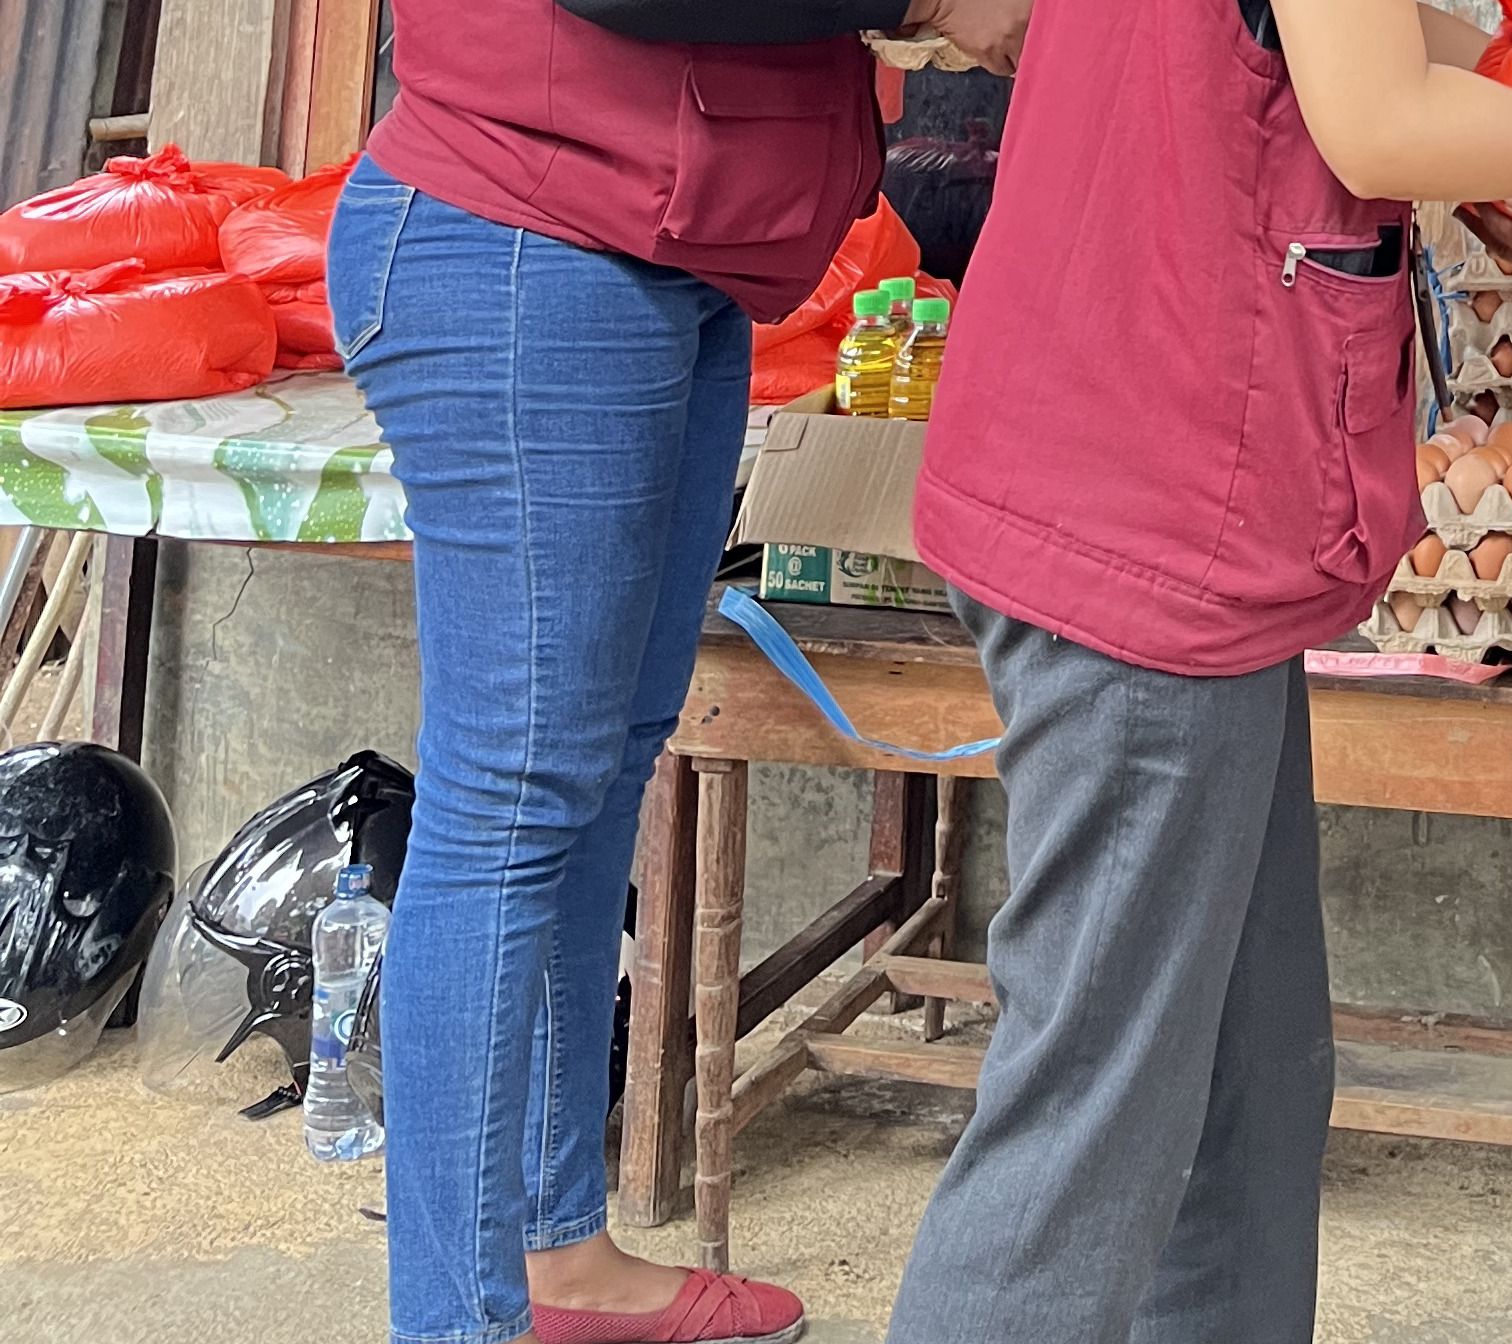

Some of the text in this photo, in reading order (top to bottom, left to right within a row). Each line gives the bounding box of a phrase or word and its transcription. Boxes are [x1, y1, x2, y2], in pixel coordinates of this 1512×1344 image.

[789, 544, 817, 558] PACK
[768, 570, 784, 589] 50
[784, 578, 825, 593] SACHET
